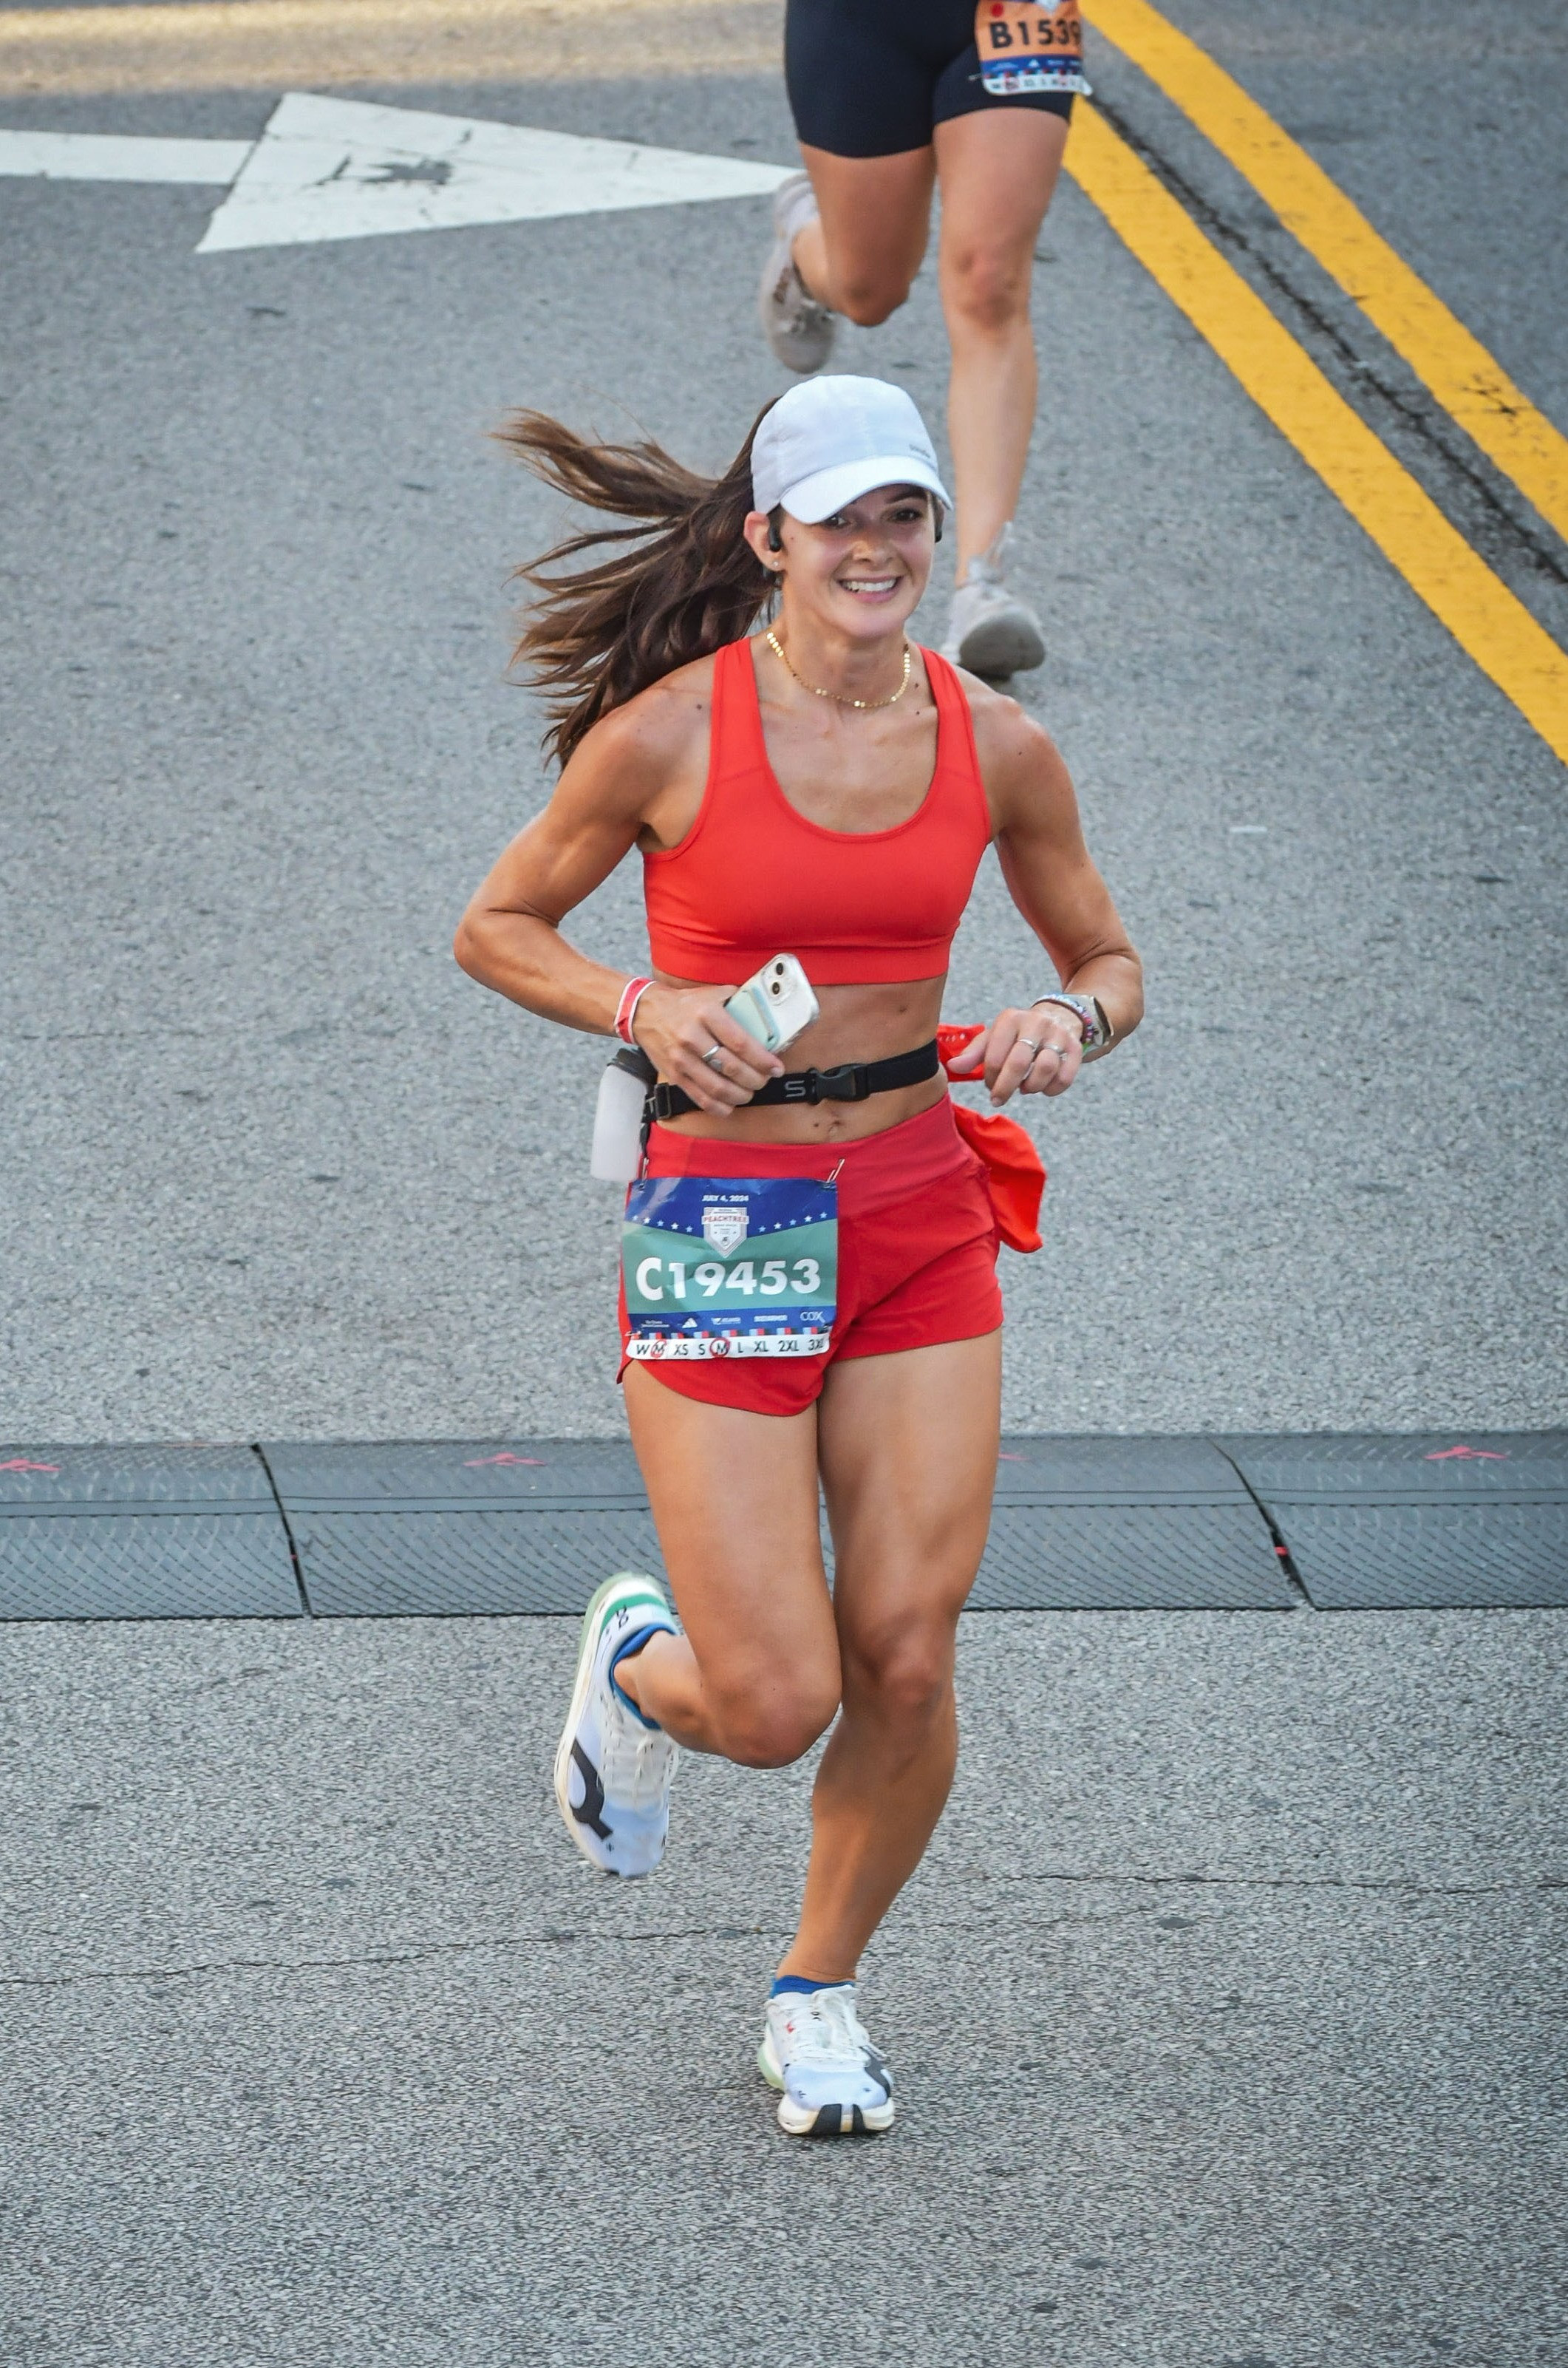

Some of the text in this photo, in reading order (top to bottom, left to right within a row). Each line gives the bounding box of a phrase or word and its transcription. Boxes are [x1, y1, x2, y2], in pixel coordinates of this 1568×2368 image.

[636, 1257, 821, 1301] C19453
[800, 1311, 825, 1323] COX
[636, 1344, 650, 1355] W
[674, 1344, 689, 1355] XS
[698, 1344, 706, 1355] S
[737, 1341, 744, 1353] L
[754, 1341, 769, 1353] XL
[778, 1340, 800, 1352] 2XL
